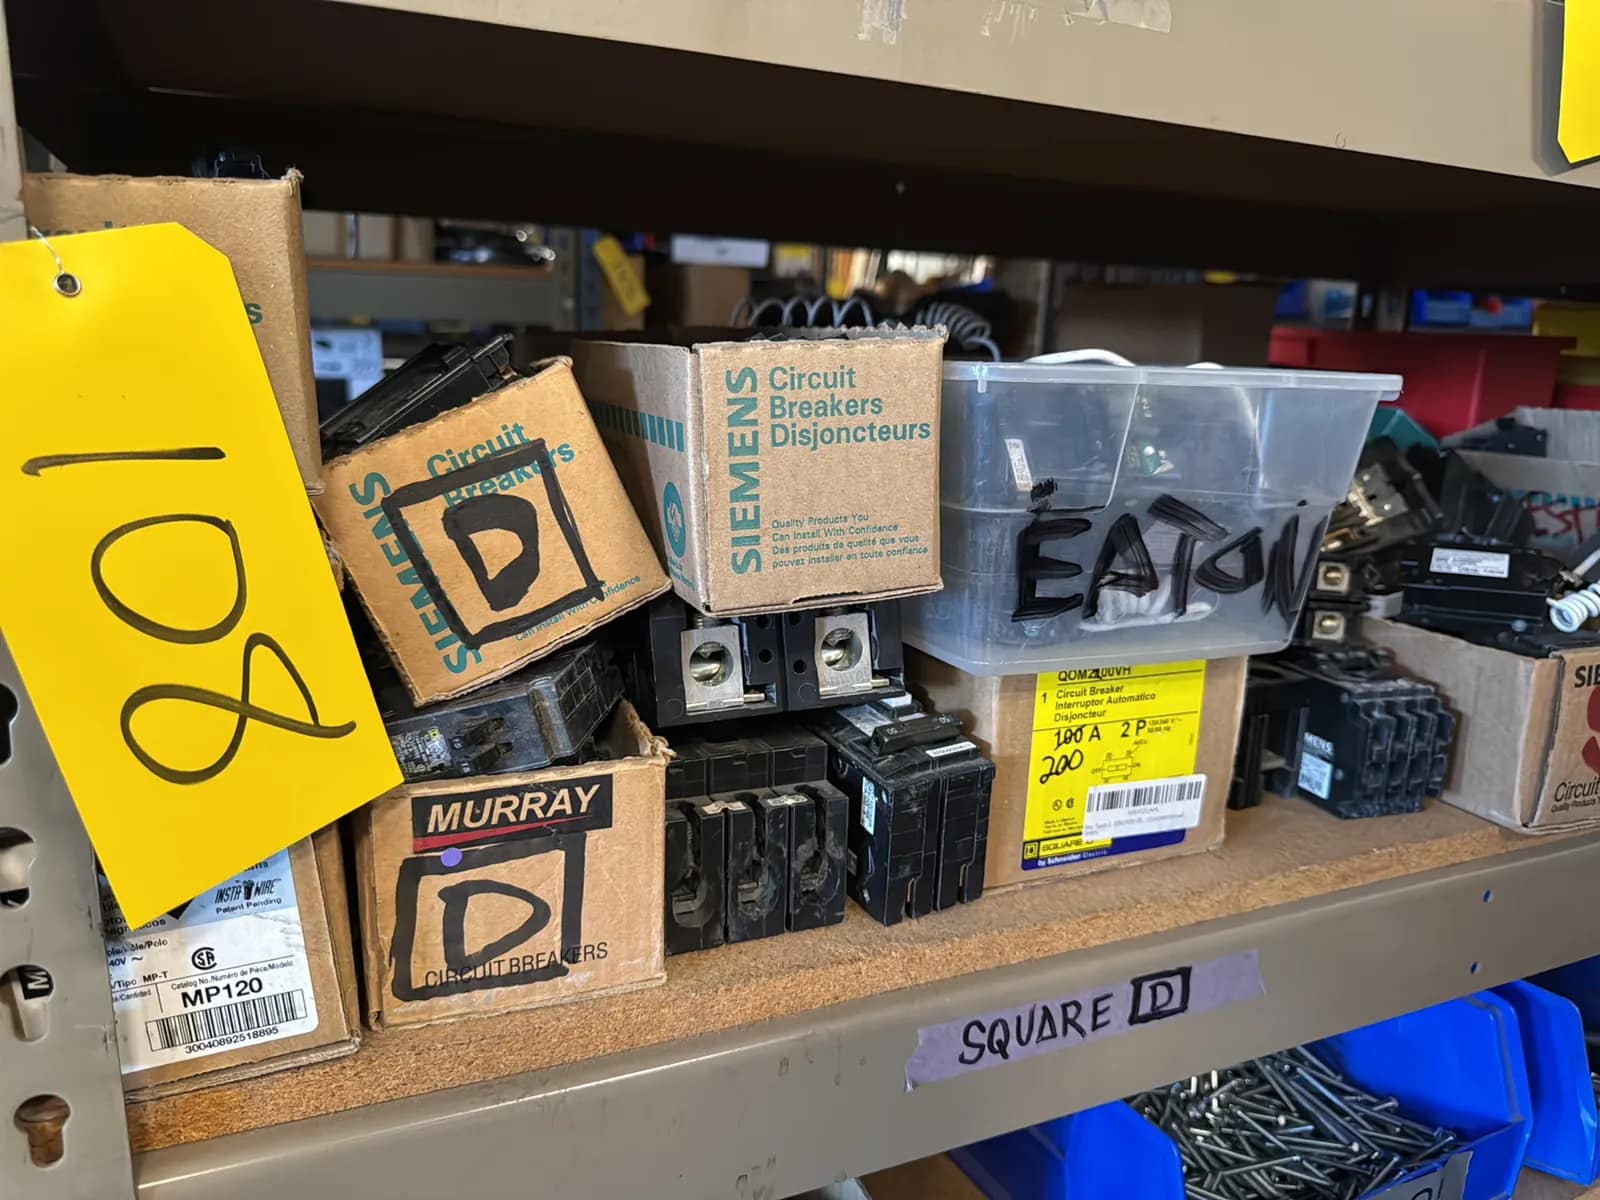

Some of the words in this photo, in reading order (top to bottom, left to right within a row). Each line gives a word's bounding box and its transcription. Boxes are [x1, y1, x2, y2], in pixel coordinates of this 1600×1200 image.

[769, 365, 857, 391] Circuit
[769, 392, 884, 420] Breakers
[770, 421, 931, 451] Disjoncteurs
[427, 421, 531, 480] Circuit
[726, 366, 762, 575] SIEMENS
[771, 517, 805, 530] Quality
[808, 515, 848, 526] Products
[851, 512, 869, 522] You
[772, 532, 790, 542] Can
[793, 529, 821, 540] Install
[824, 527, 846, 537] With
[848, 523, 898, 535] Confidence
[442, 494, 540, 613] D
[772, 544, 790, 555] Des
[793, 541, 830, 555] produits
[833, 539, 844, 549] de
[847, 538, 877, 549] qualité
[879, 537, 896, 547] que
[898, 534, 920, 543] vous
[772, 557, 805, 569] pouvez
[808, 552, 844, 564] installer
[846, 552, 858, 560] en
[860, 548, 884, 559] toute
[886, 546, 928, 557] confiance
[1011, 494, 1331, 623] EATON
[1041, 691, 1048, 704] 1
[1055, 697, 1105, 711] Interruptor
[1056, 686, 1087, 700] Circuit
[1089, 684, 1124, 697] Breaker
[1054, 709, 1107, 724] Disjoncteur
[1088, 725, 1101, 743] A
[1120, 721, 1131, 738] 2
[1135, 719, 1147, 737] P
[1039, 749, 1084, 785] 200
[427, 783, 601, 834] MURRAY
[1041, 838, 1083, 852] SQUARE
[215, 903, 245, 914] Patent
[245, 897, 282, 909] Pending
[438, 879, 552, 977] D
[142, 970, 169, 983] MP-T
[425, 958, 503, 988] CIRCUIT
[509, 941, 609, 975] BREAKERS
[171, 978, 198, 991] Catalog
[240, 968, 248, 977] de
[181, 976, 264, 1009] MP120
[184, 1026, 279, 1055] 30040892518895
[958, 992, 1113, 1066] SQUARE
